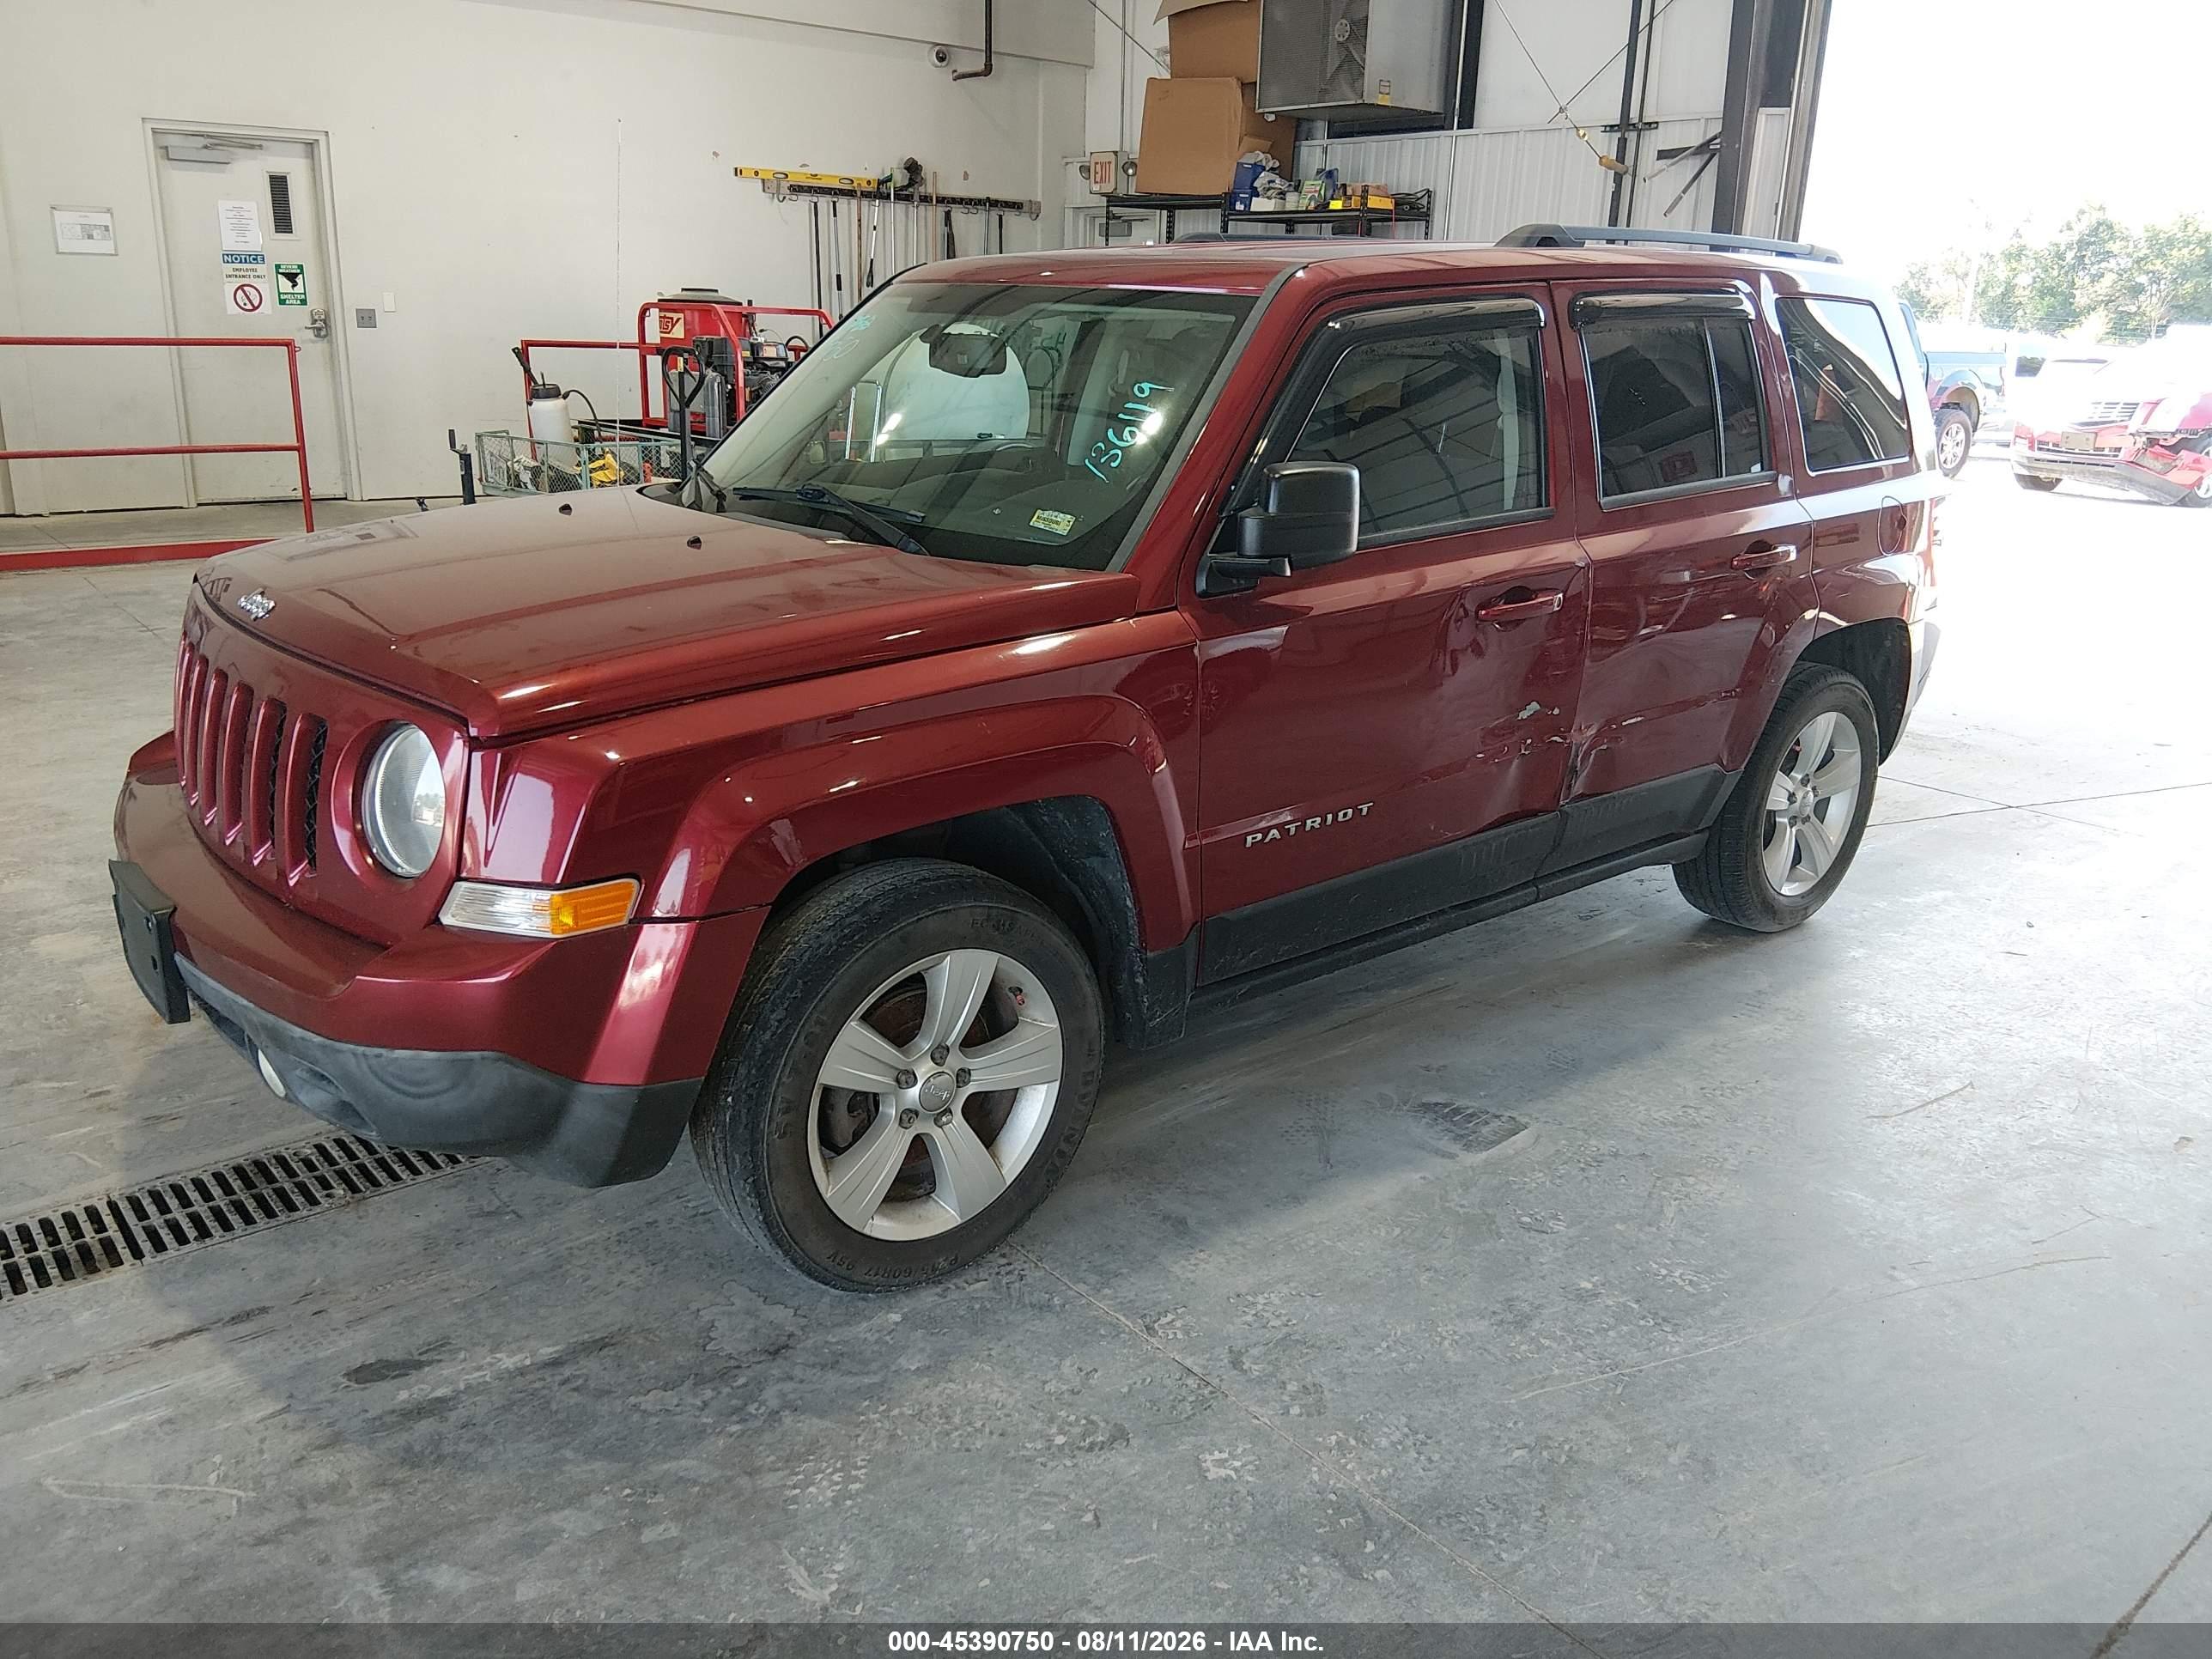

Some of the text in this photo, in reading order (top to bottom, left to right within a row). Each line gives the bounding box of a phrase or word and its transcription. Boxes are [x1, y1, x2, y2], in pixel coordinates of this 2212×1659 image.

[1094, 161, 1112, 185] EXIT
[223, 254, 264, 264] NOTICE
[1085, 381, 1176, 483] 136119
[1245, 802, 1374, 848] PATRIOT
